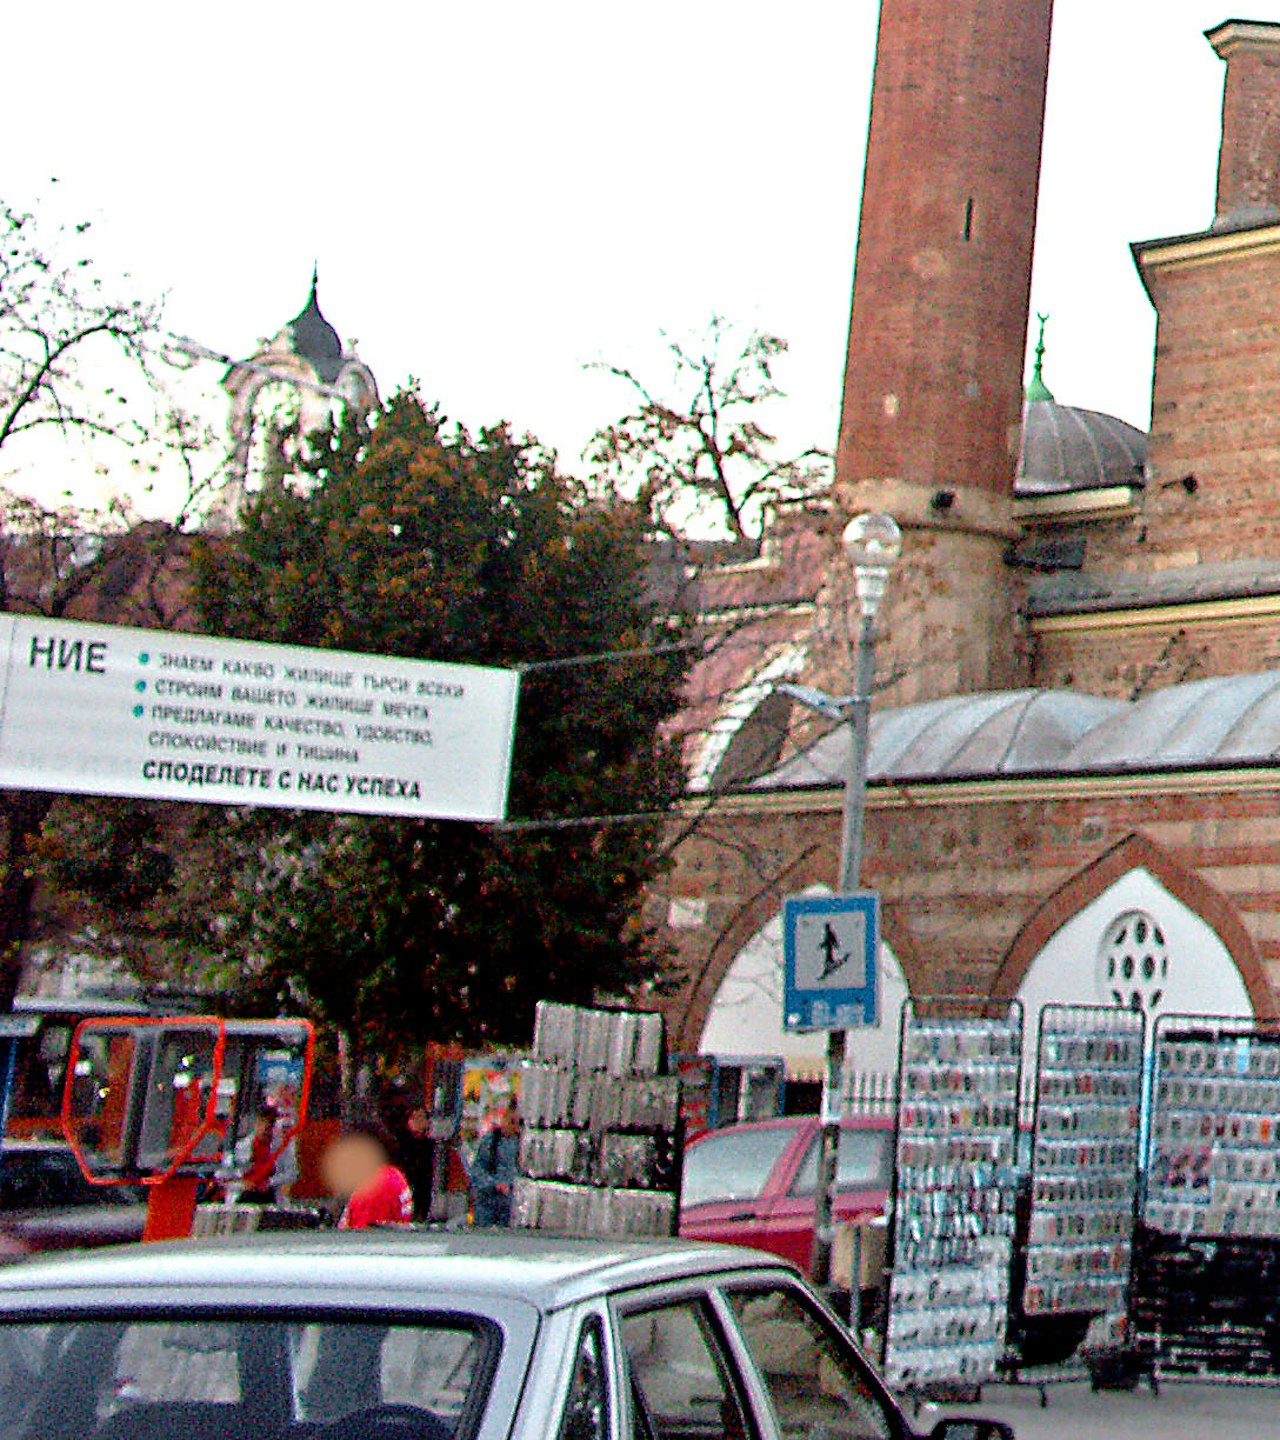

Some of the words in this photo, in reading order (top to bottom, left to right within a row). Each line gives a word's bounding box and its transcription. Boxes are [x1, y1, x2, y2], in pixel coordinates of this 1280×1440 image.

[30, 636, 107, 674] НИЕ
[160, 653, 213, 671] ЗНАЕМ
[222, 660, 274, 679] КАКВО
[155, 679, 223, 698] СТРОИМ
[231, 686, 296, 706] ВАШЕТО
[152, 705, 256, 728] ПРЕДЛАГАМЕ
[276, 742, 287, 757] И
[142, 761, 272, 790] СПОДЕЛЕТЕ
[278, 771, 291, 790] С
[298, 772, 339, 793] НАС
[346, 776, 421, 801] УСПЕХА
